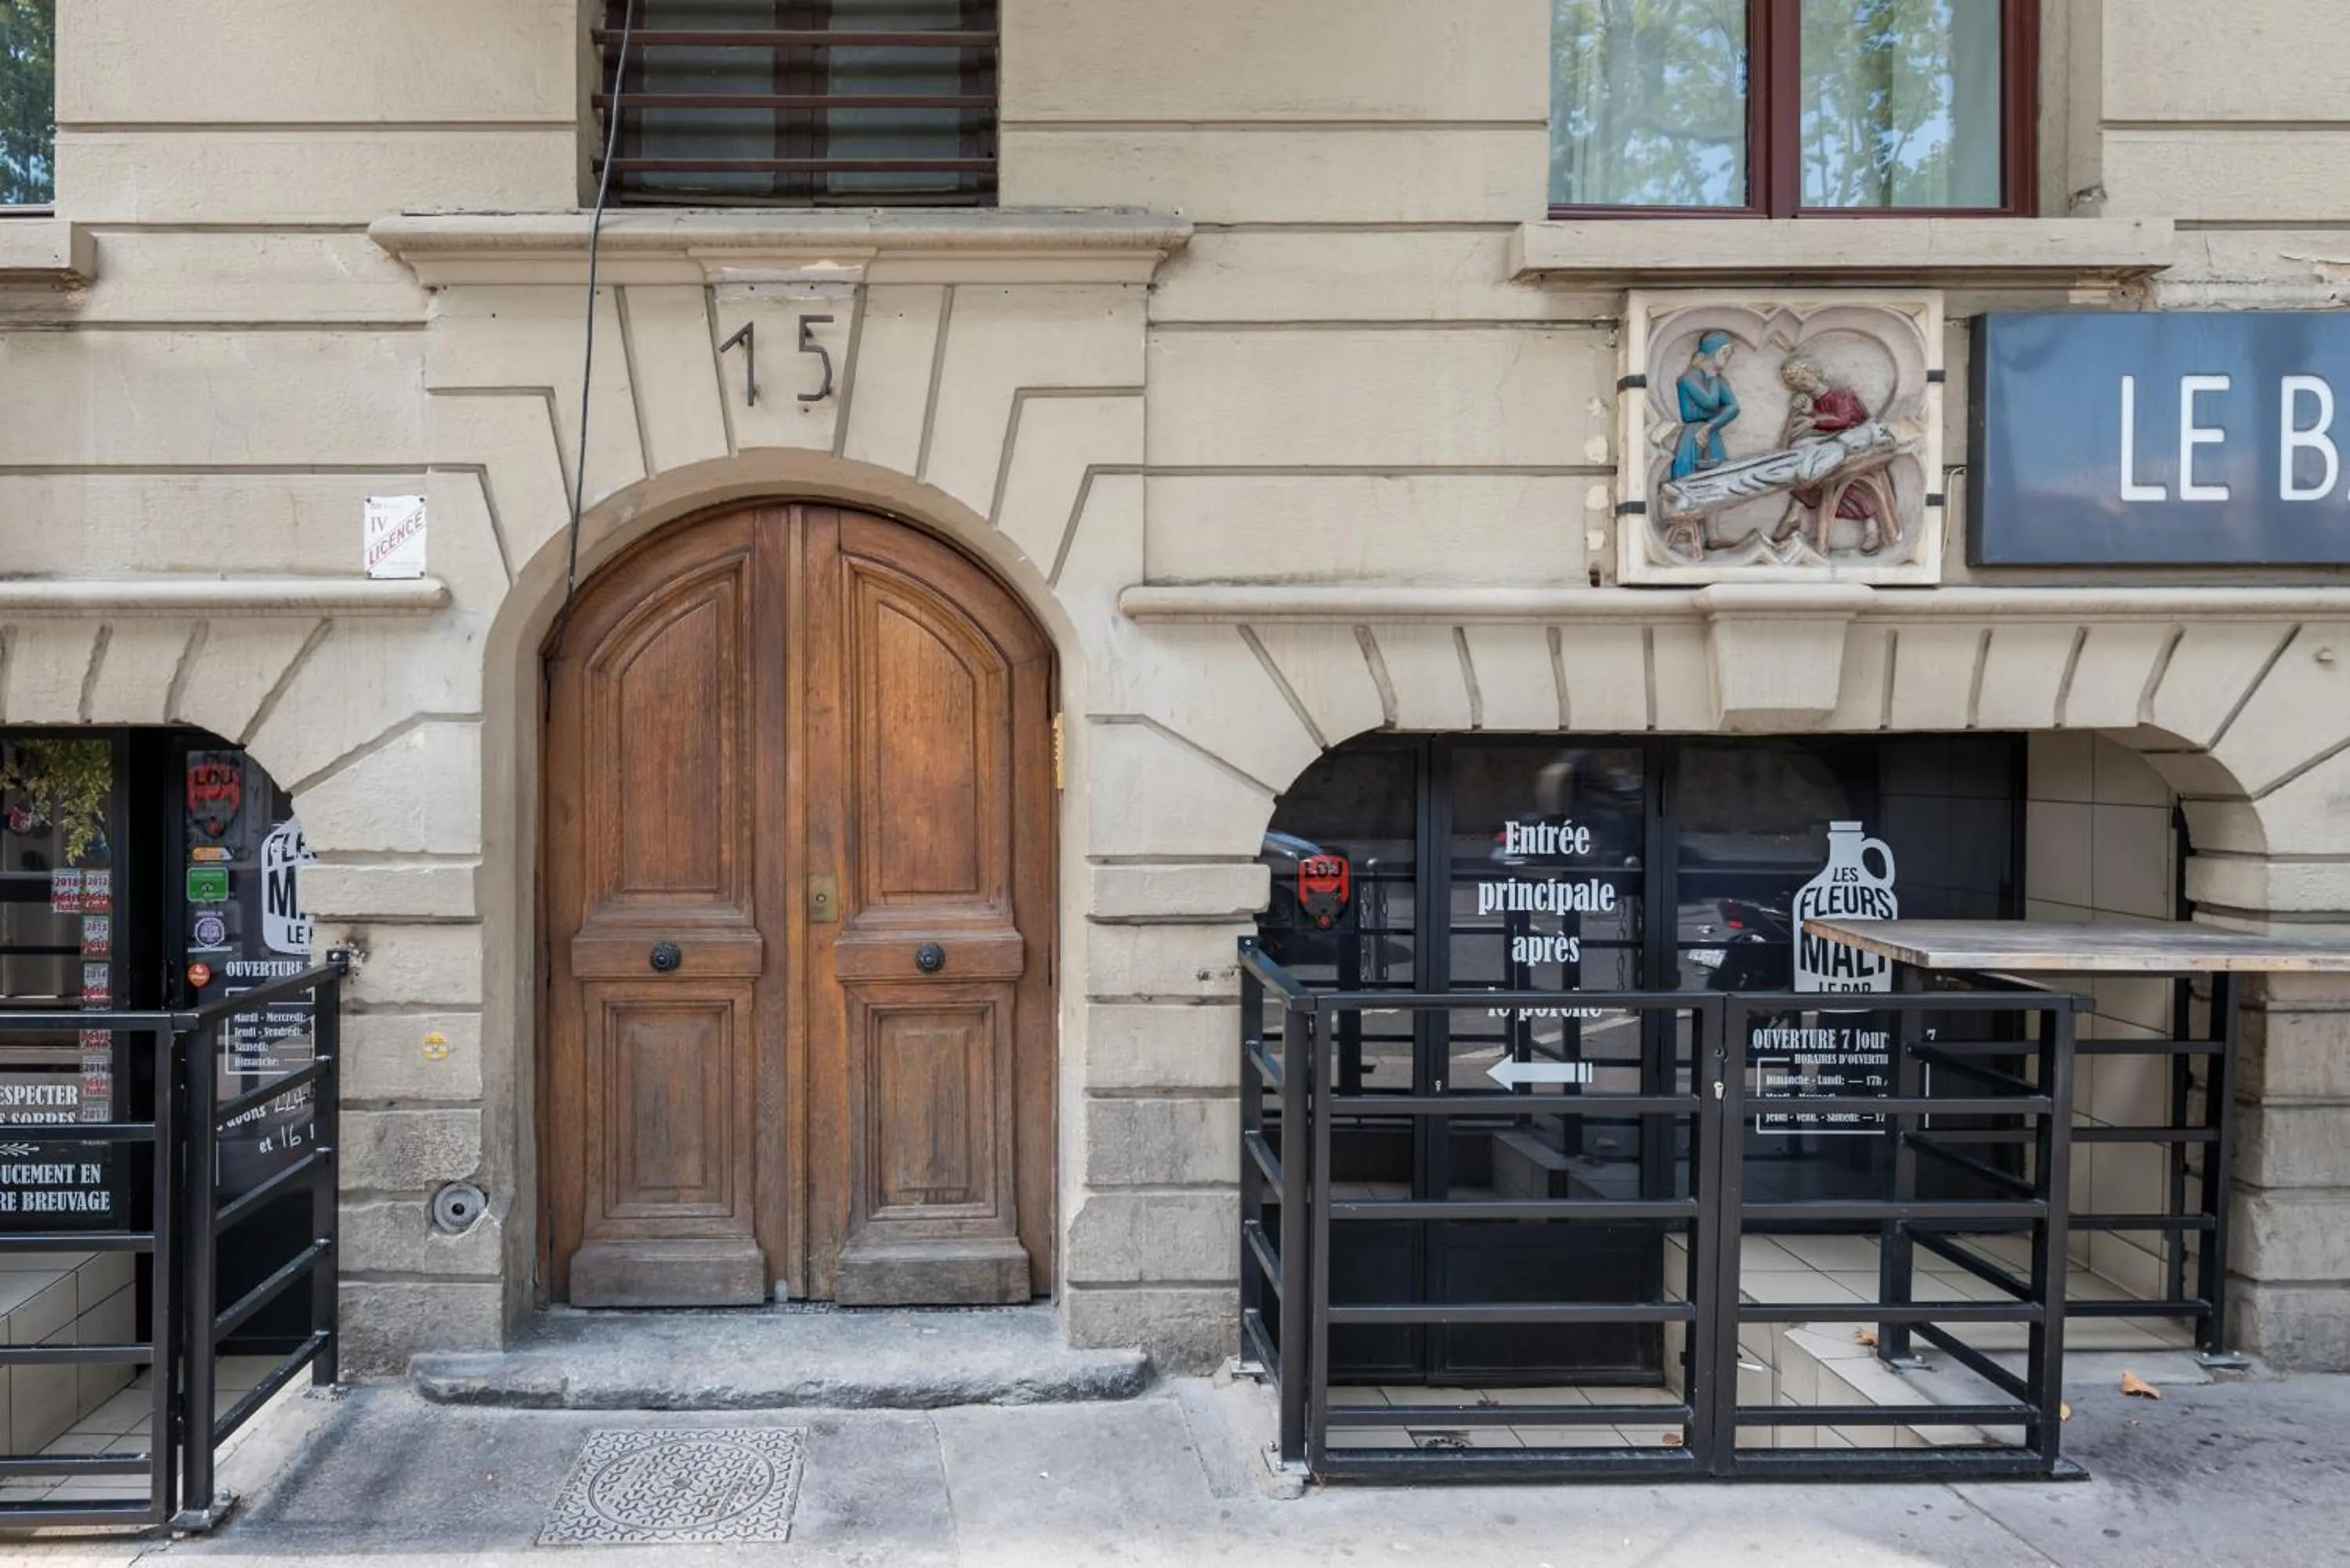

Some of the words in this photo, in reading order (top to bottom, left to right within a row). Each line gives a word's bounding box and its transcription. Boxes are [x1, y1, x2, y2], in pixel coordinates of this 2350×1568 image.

[718, 314, 834, 407] 15
[2120, 375, 2230, 501] LE
[2280, 375, 2350, 501] B
[371, 516, 388, 533] IV
[369, 511, 424, 565] LICENCE
[1505, 820, 1590, 855] Entrée
[1304, 861, 1343, 878] LOU
[1831, 866, 1859, 883] LES
[1478, 878, 1614, 915] principale
[1799, 885, 1893, 922] FLEURS
[287, 925, 305, 945] LE
[1512, 931, 1579, 966] après
[1752, 1028, 1836, 1050] OUVERTURE
[1841, 1029, 1851, 1050] 7
[1838, 1053, 1889, 1064] D'OUVERTU
[259, 1137, 273, 1154] et
[0, 1164, 75, 1184] UCEMENT
[81, 1164, 101, 1183] EN
[22, 1190, 110, 1212] BREUVAGE
